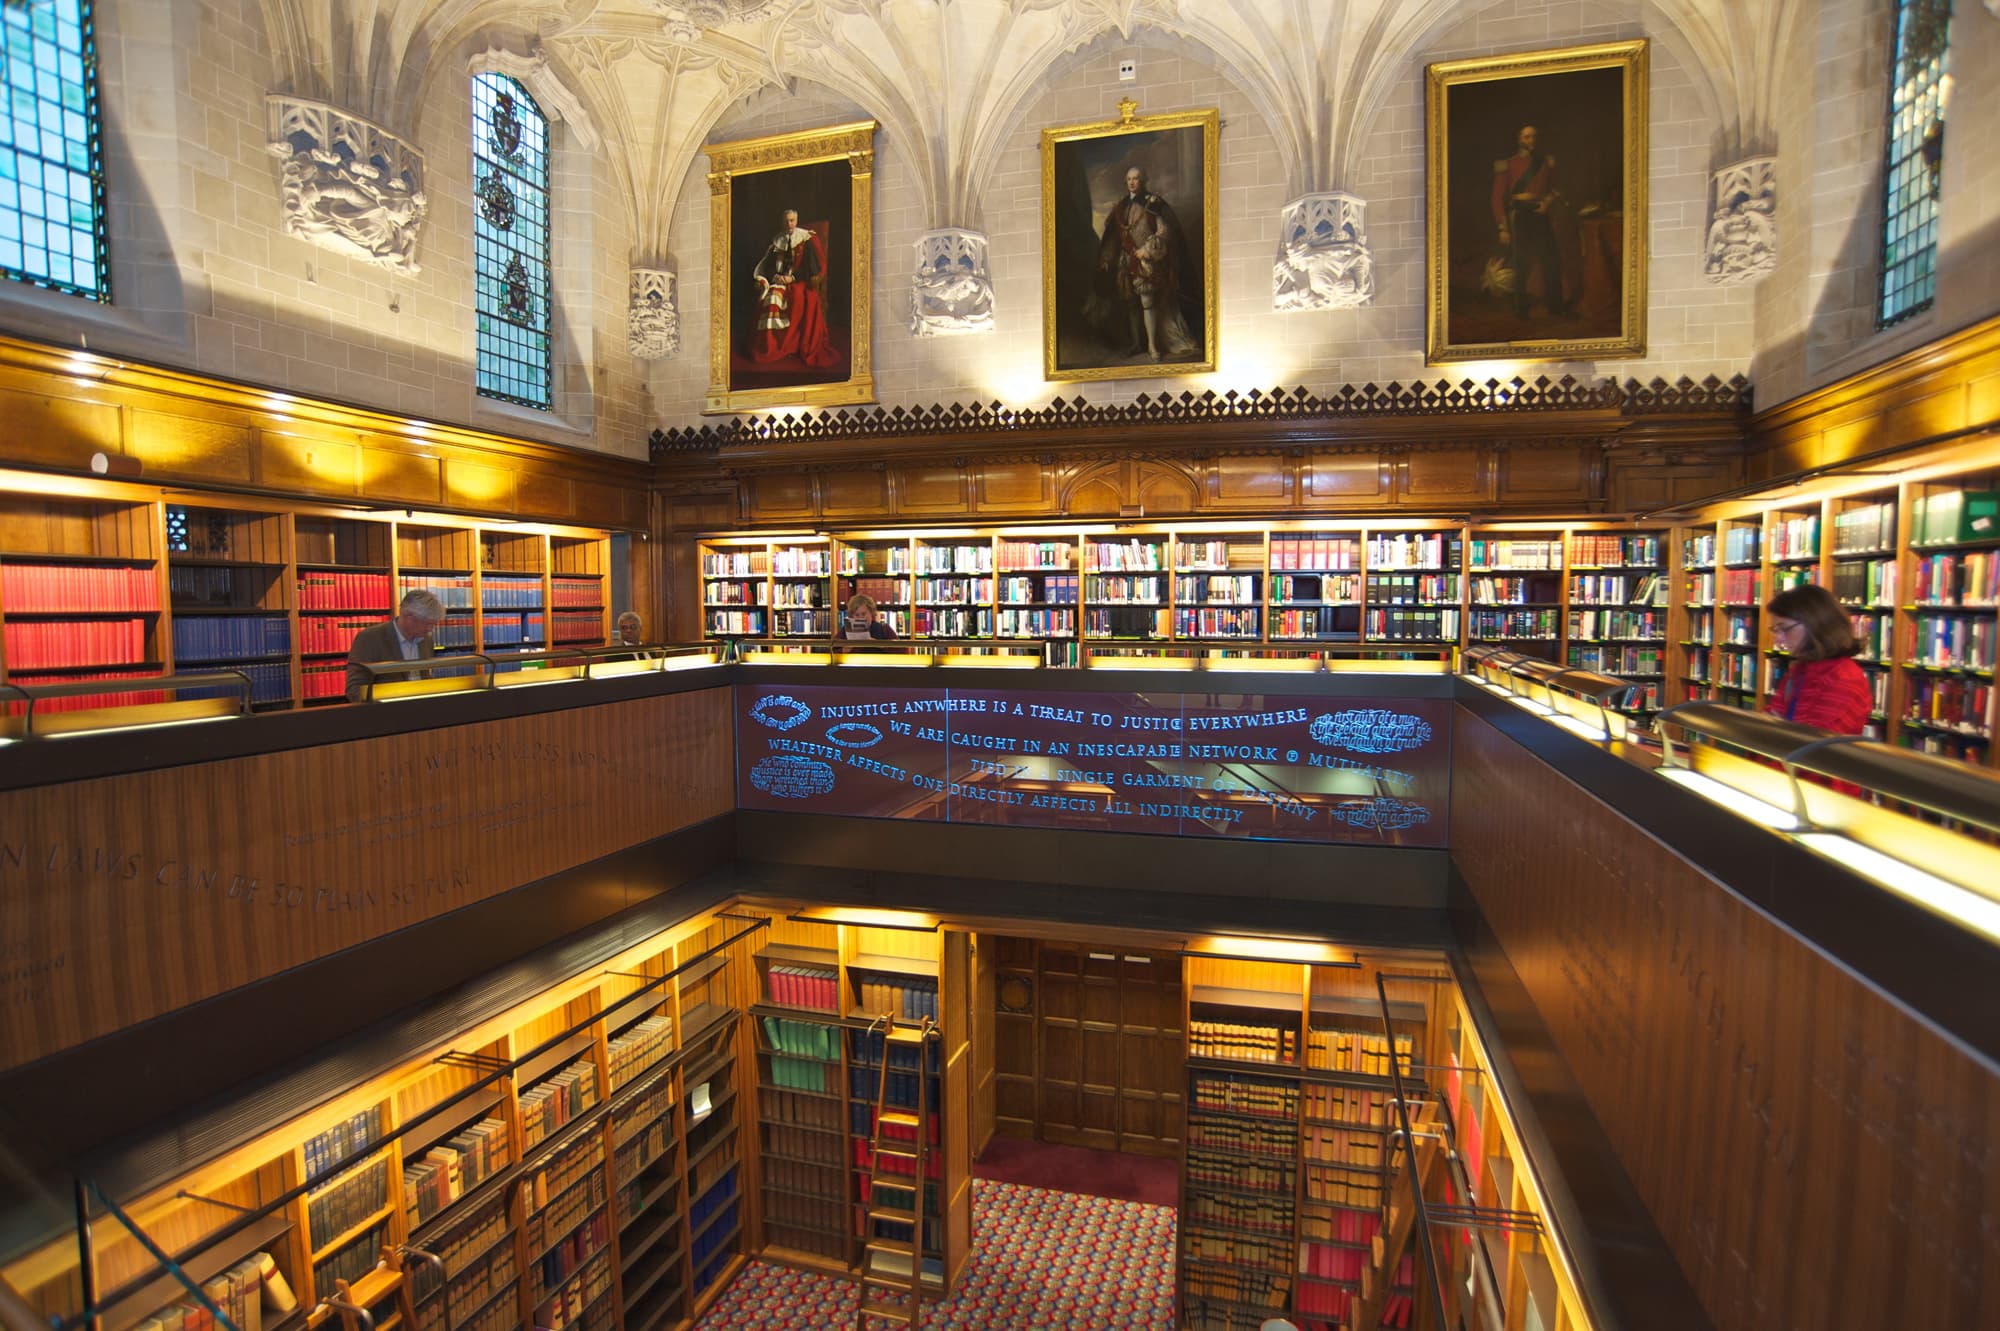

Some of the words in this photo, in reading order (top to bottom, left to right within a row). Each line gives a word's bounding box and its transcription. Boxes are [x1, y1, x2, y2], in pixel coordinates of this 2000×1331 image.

[821, 703, 898, 718] INJUSTICE
[904, 700, 986, 713] ANYWHERE
[993, 701, 1007, 713] IS
[1012, 703, 1023, 716] A
[1030, 705, 1084, 723] THREAT
[1091, 713, 1112, 726] TO
[1190, 708, 1308, 730] EVERYWHERE
[768, 739, 843, 761] WHATEVER
[847, 754, 906, 781] AFFECTS
[912, 775, 943, 792] ONE
[950, 784, 1024, 805] DIRECTLY
[1030, 795, 1096, 812] AFFECTS
[1104, 801, 1132, 814] ALL
[1139, 803, 1244, 823] INDIRECTLY
[890, 720, 911, 735] WE
[916, 727, 945, 742] ARE
[951, 733, 1016, 750] CAUGHT
[1023, 740, 1041, 753] IN
[1048, 742, 1070, 754] AN
[1077, 743, 1182, 757] INESCAPABLE
[1189, 745, 1278, 760] NETWORK
[1308, 752, 1415, 787] MUTUALITY
[971, 759, 1006, 776] TIED
[1057, 769, 1115, 785] SINGLE
[1122, 773, 1205, 789] GARMENT
[1212, 779, 1235, 794] OF
[1242, 785, 1318, 821] DESTINY
